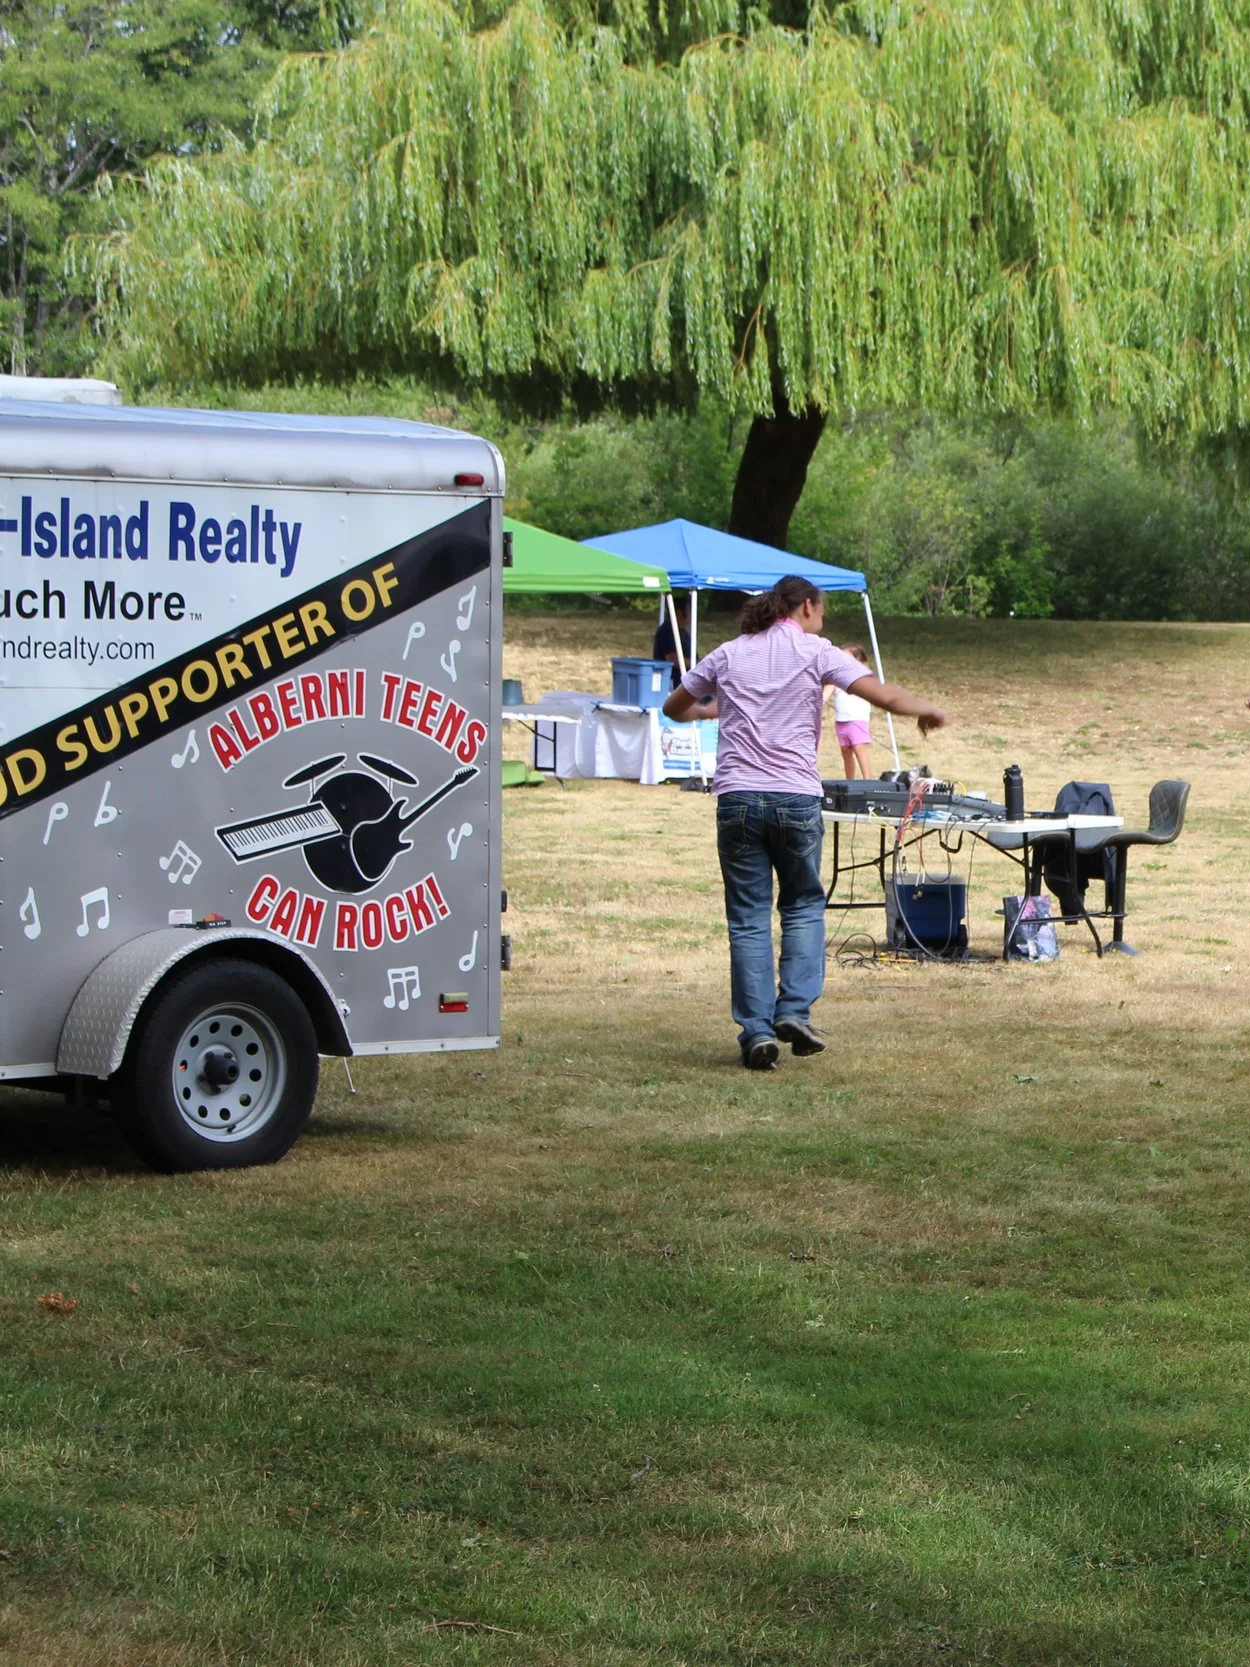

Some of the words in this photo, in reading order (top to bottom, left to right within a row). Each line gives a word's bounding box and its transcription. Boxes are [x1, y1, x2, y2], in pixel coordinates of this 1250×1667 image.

[169, 501, 302, 578] Realty
[84, 581, 186, 621] More
[56, 601, 335, 771] SUPPORTER
[340, 562, 399, 622] OF
[208, 669, 366, 773] ALBERNI
[380, 671, 487, 764] TEENS
[246, 874, 328, 949] CAN
[333, 872, 451, 952] ROCK!
